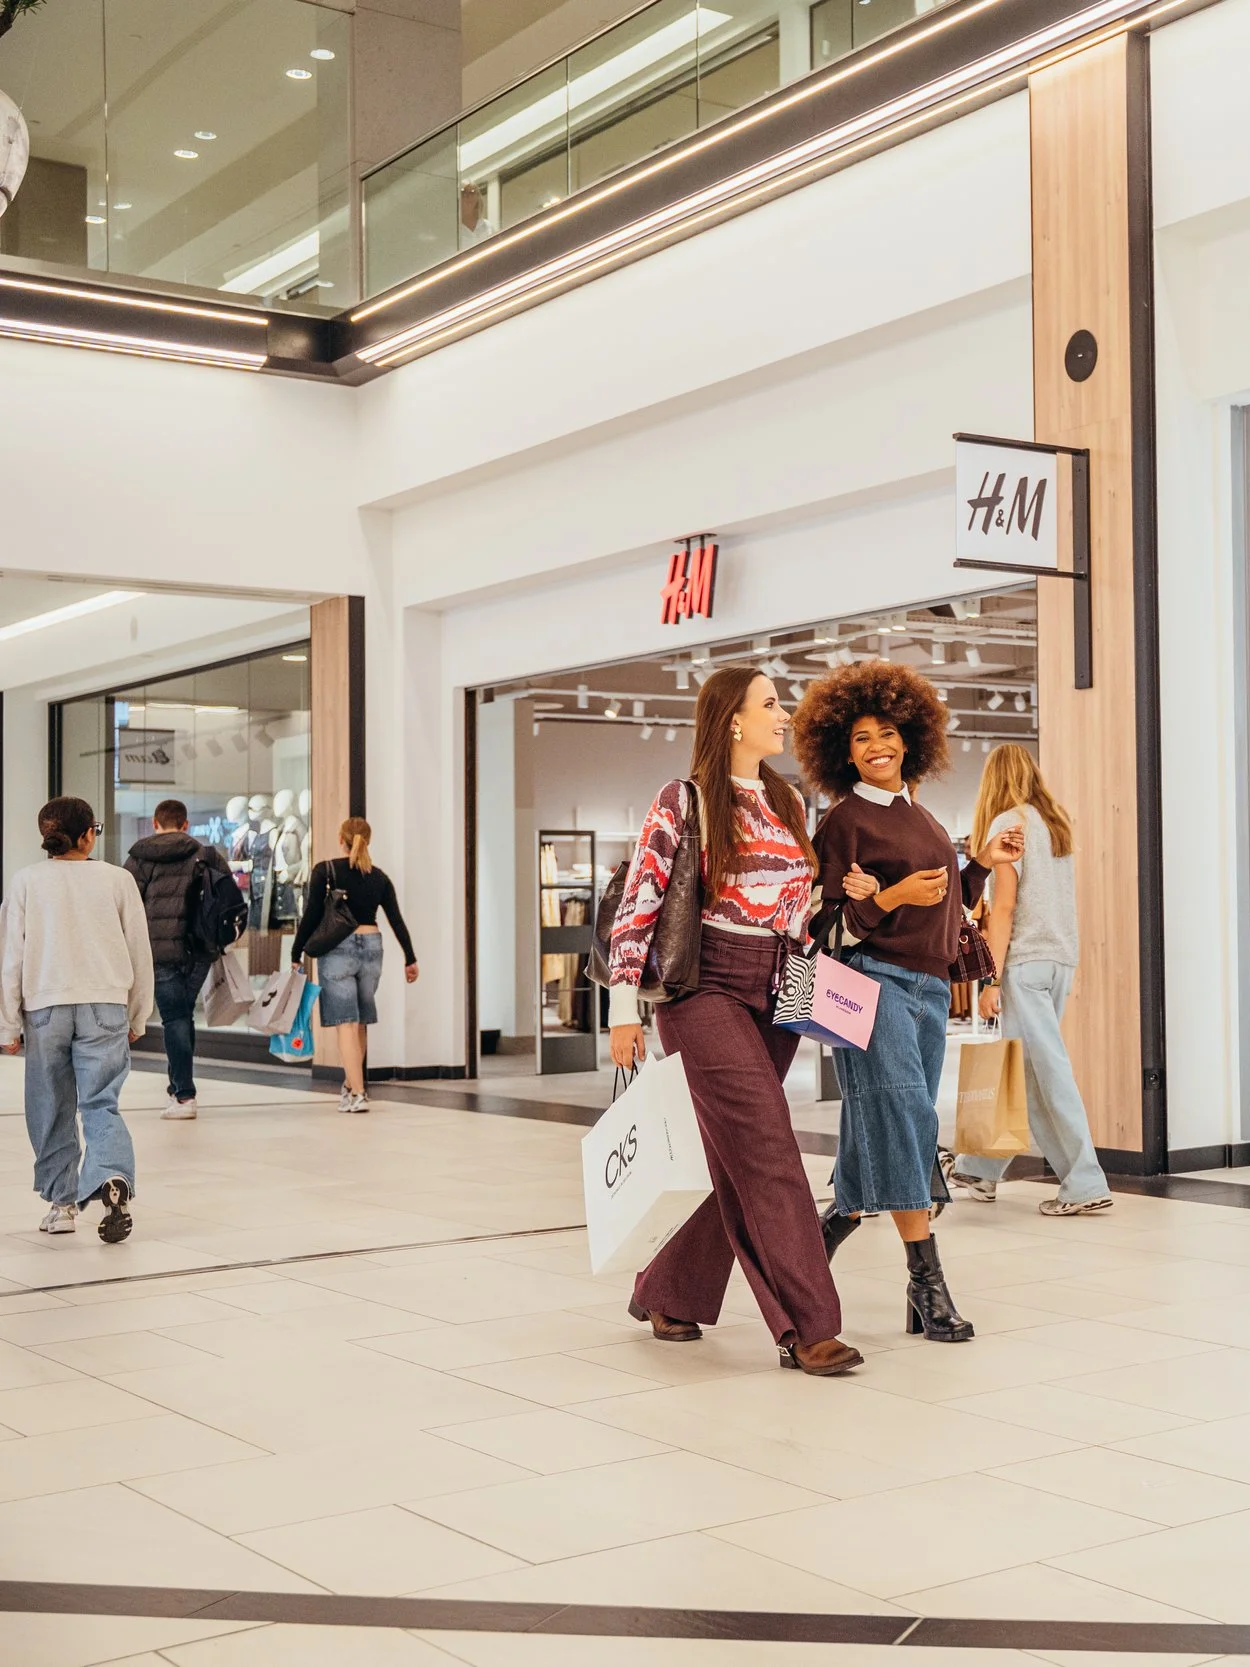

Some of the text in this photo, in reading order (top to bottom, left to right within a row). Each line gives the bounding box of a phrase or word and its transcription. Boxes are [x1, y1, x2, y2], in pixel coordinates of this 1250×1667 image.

[967, 471, 1047, 541] H&M
[660, 544, 719, 624] H&M
[826, 989, 863, 1014] EYECANDY
[605, 1124, 637, 1189] CKS
